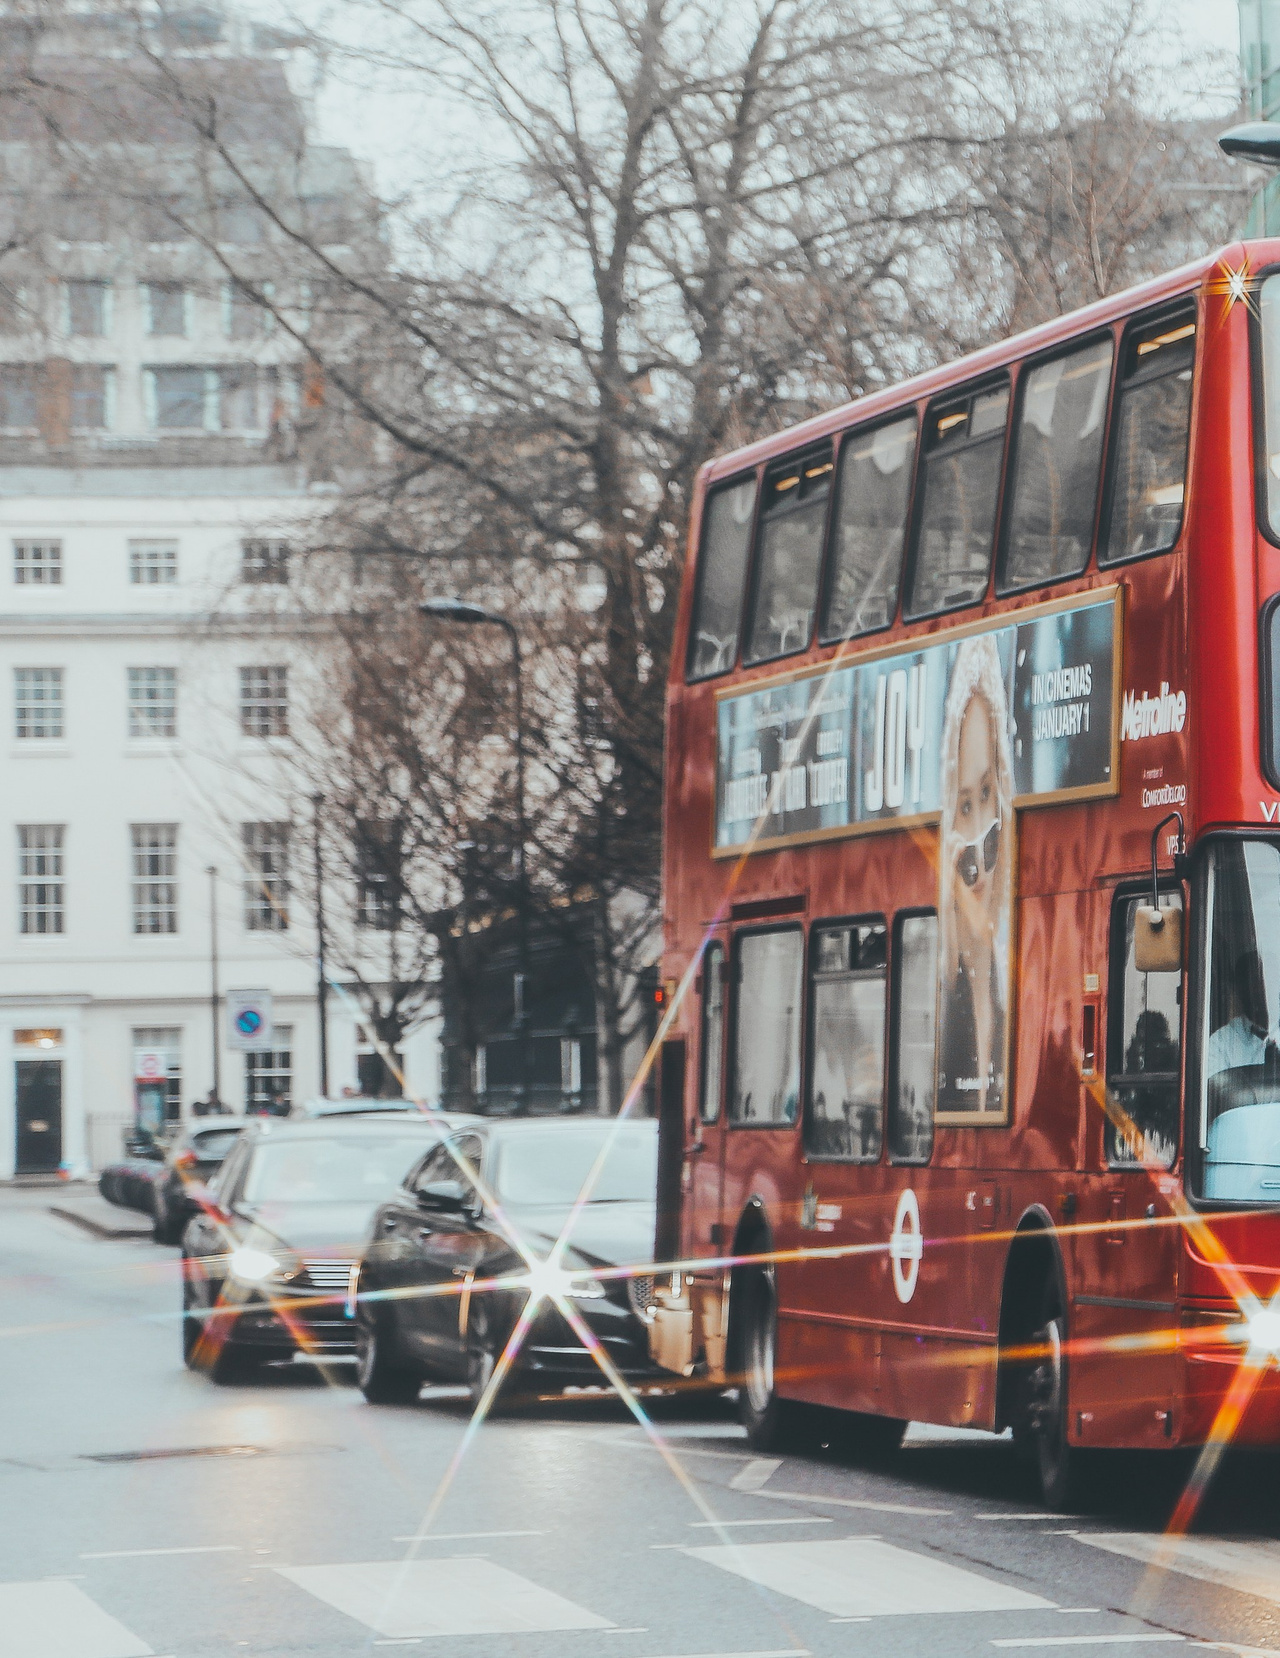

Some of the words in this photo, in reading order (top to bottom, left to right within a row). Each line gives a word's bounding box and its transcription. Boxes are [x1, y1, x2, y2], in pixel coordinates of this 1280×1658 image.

[1031, 673, 1045, 705] IN
[1047, 663, 1092, 701] CINEMAS
[1034, 703, 1085, 742] JANUARY
[1084, 702, 1091, 732] 1
[1121, 681, 1186, 741] Metroline
[864, 663, 927, 812] JOY
